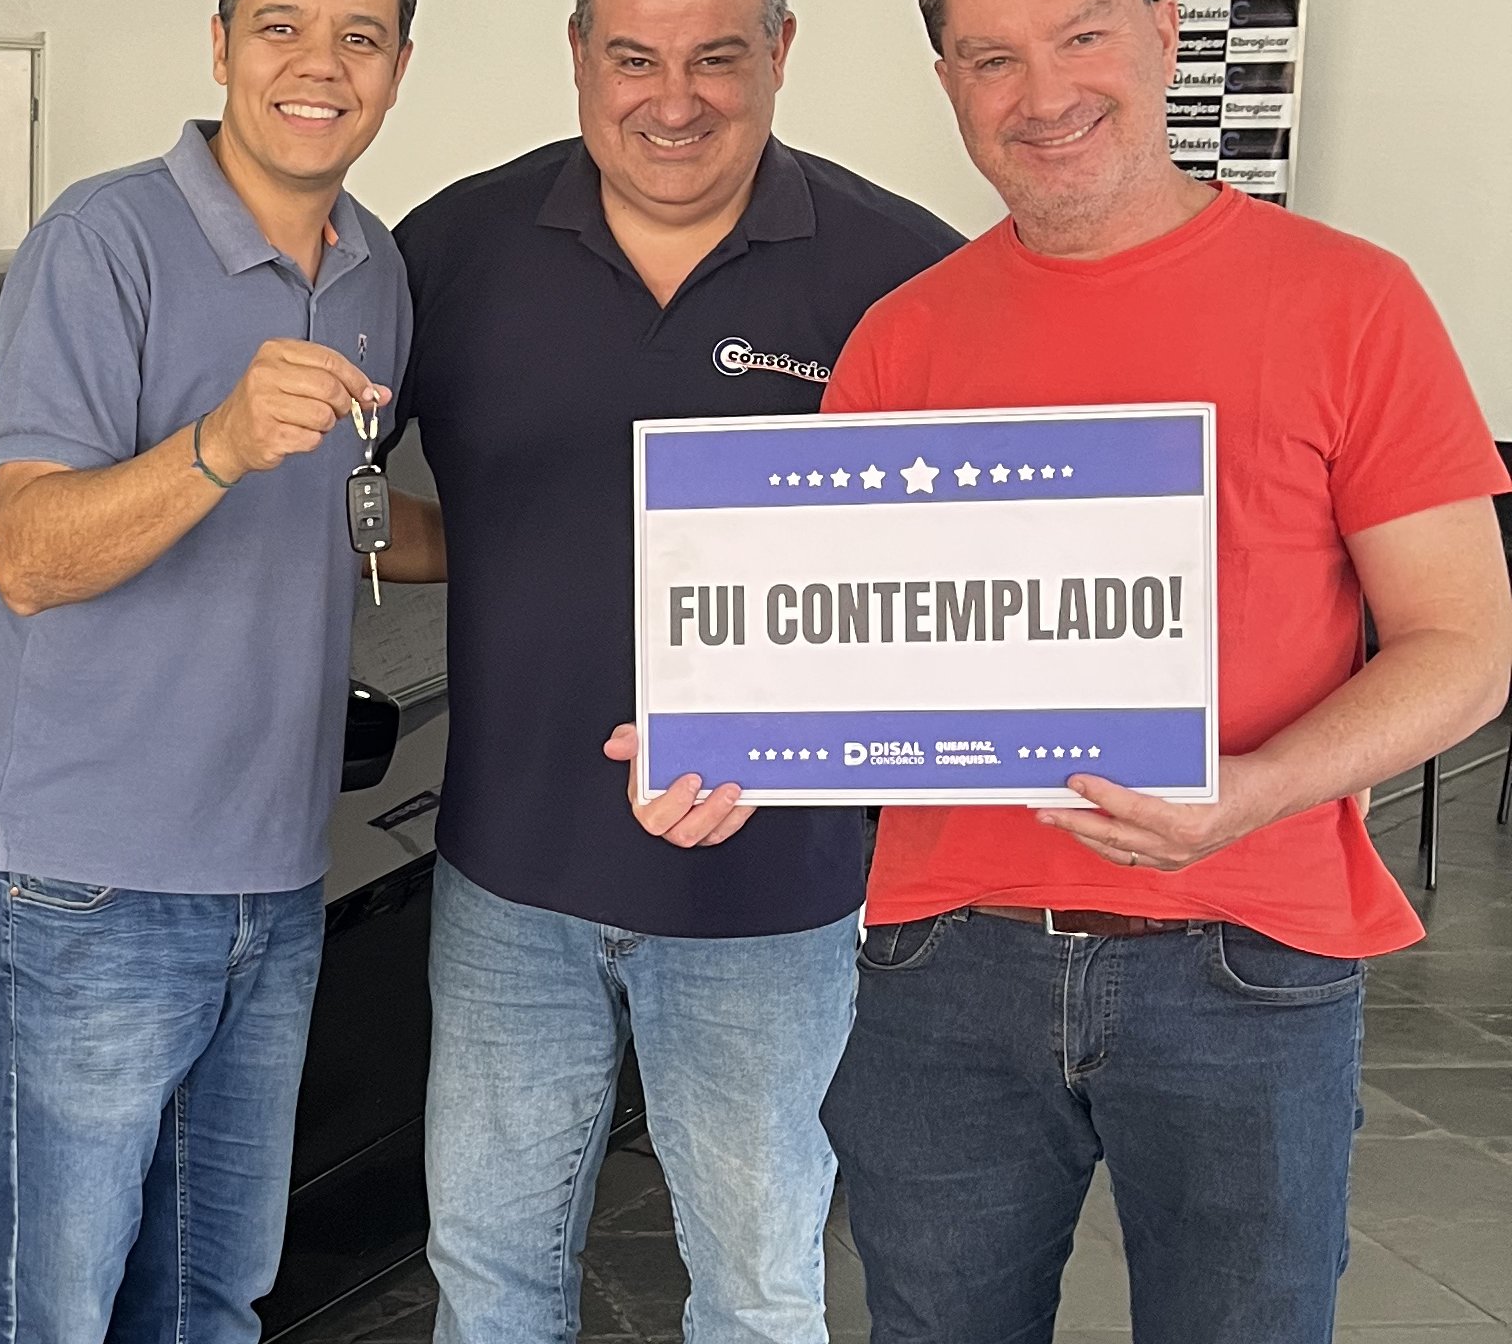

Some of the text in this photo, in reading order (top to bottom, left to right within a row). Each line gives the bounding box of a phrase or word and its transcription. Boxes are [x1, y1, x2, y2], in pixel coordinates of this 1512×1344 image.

[669, 576, 1185, 647] FUI CONTEMPLADO!
[870, 741, 925, 756] DISAL
[935, 740, 995, 753] QUEM FAZ,
[870, 753, 925, 765] CONSÓRCIO
[935, 755, 1002, 766] CONQUISTA.
